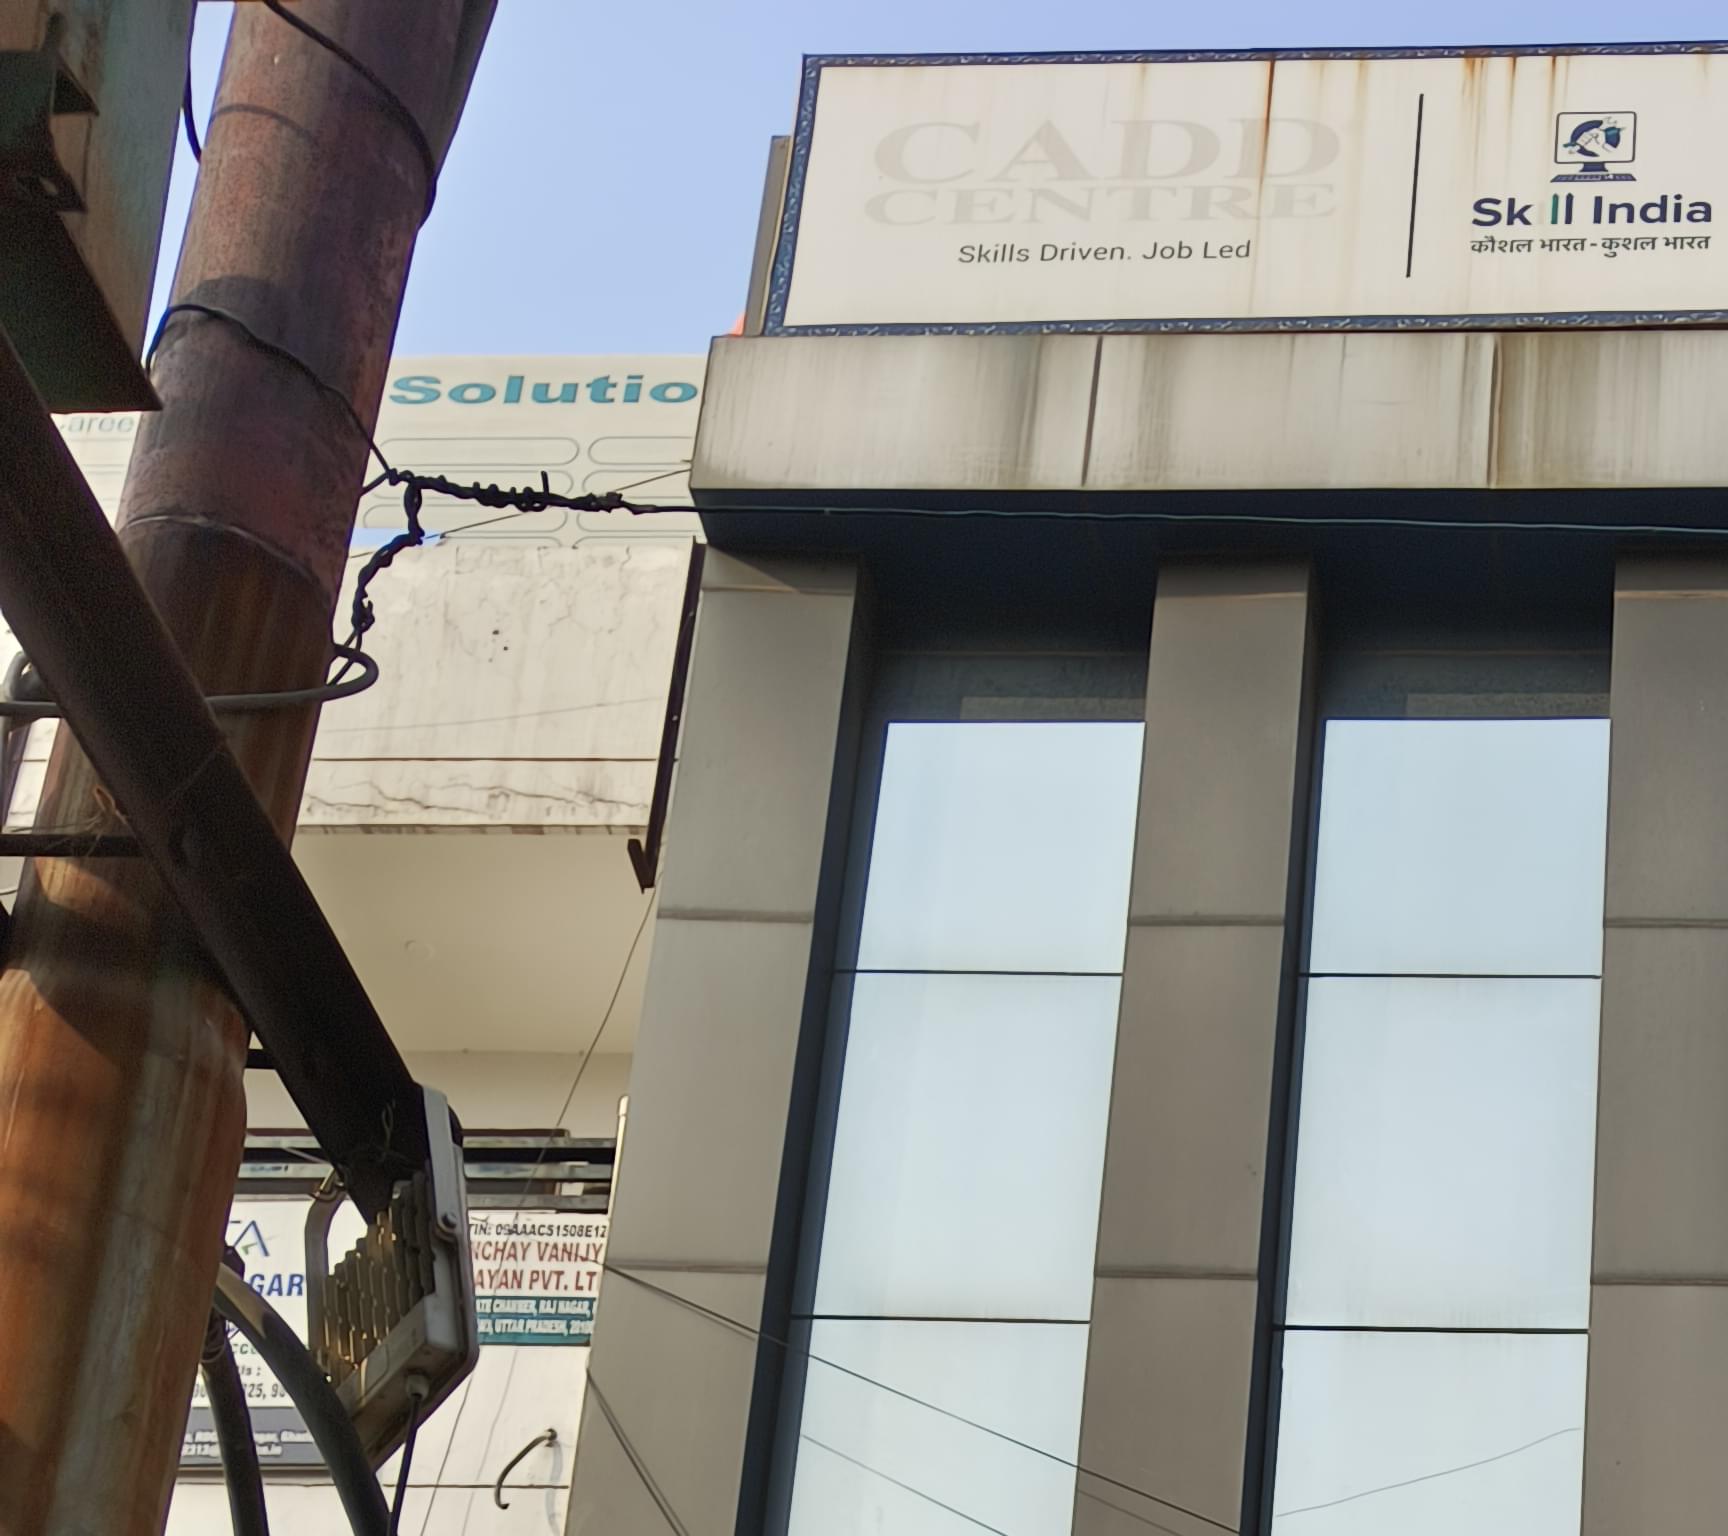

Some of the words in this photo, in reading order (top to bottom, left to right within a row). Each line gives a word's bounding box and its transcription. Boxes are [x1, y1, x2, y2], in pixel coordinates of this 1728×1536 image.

[874, 117, 1341, 184] CADD
[864, 183, 1337, 227] CENTRE
[1472, 192, 1574, 226] Skll
[1593, 194, 1712, 224] India
[957, 242, 1030, 263] Skills
[1040, 241, 1132, 262] Driven.
[1142, 240, 1193, 261] Job
[1203, 239, 1252, 259] Led
[1470, 235, 1532, 253] कौशल
[1540, 237, 1587, 251] भारत
[1601, 236, 1657, 258] कुशल
[1664, 236, 1711, 250] भारत
[529, 1269, 568, 1290] PVT.
